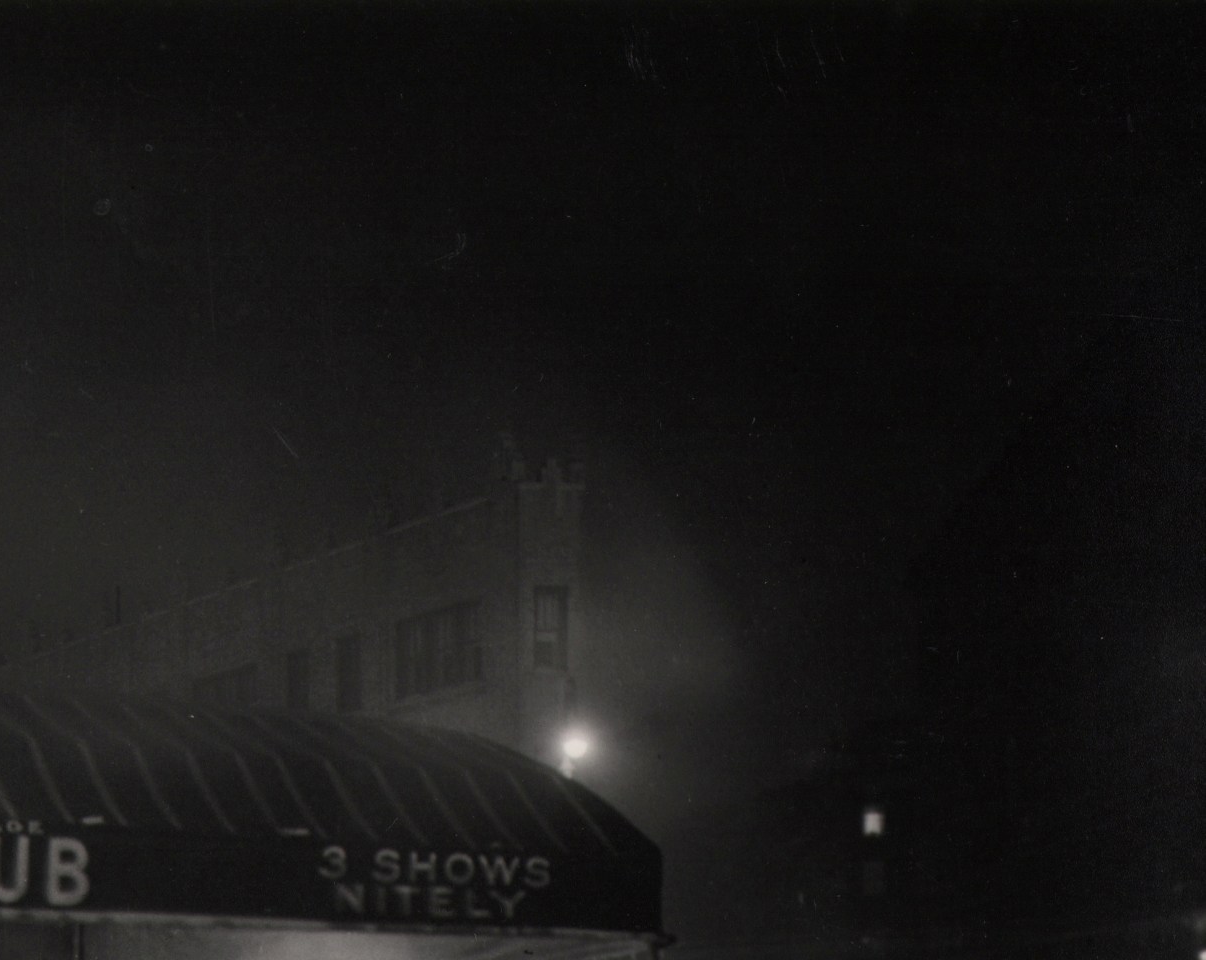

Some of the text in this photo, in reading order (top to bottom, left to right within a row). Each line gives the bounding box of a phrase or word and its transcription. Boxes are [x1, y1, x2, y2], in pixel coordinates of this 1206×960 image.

[317, 844, 552, 889] 3 SHOWS
[335, 882, 527, 920] NITELY
